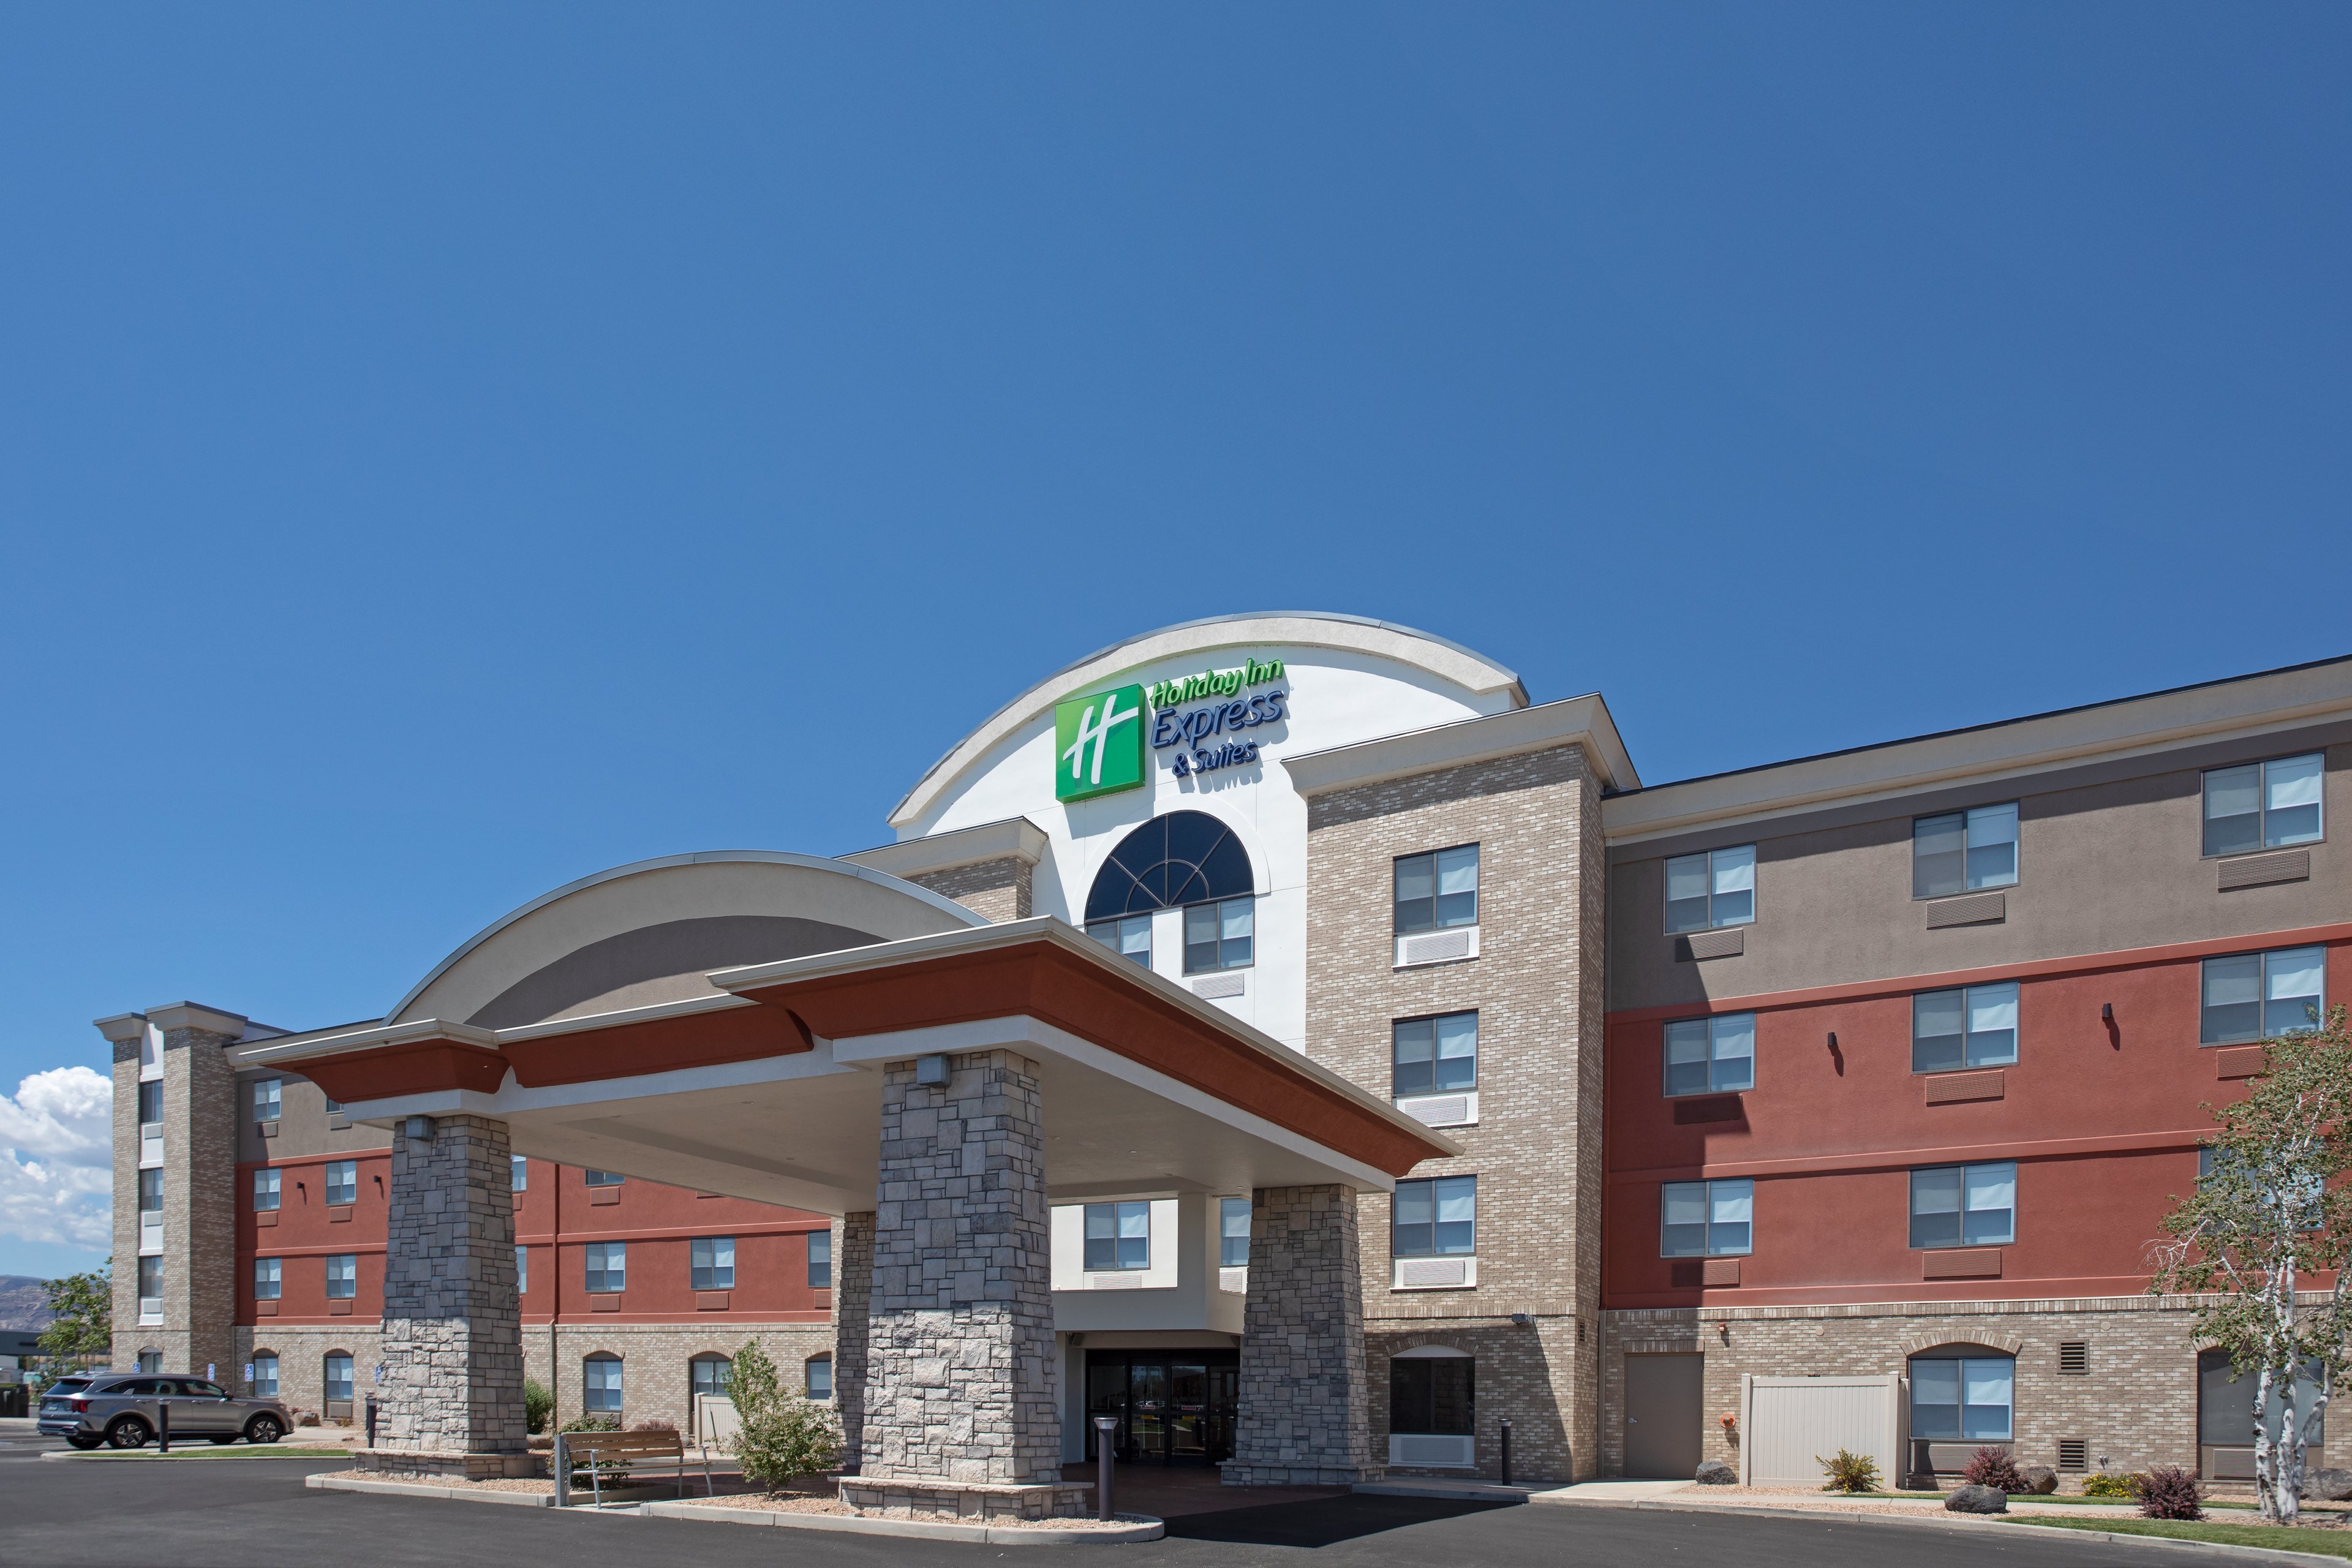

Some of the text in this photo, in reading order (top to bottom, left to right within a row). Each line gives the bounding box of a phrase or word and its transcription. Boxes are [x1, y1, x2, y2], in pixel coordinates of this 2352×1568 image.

[1150, 658, 1284, 710] Holiday Inn
[1150, 690, 1284, 750] Express
[1172, 742, 1258, 778] & Suites
